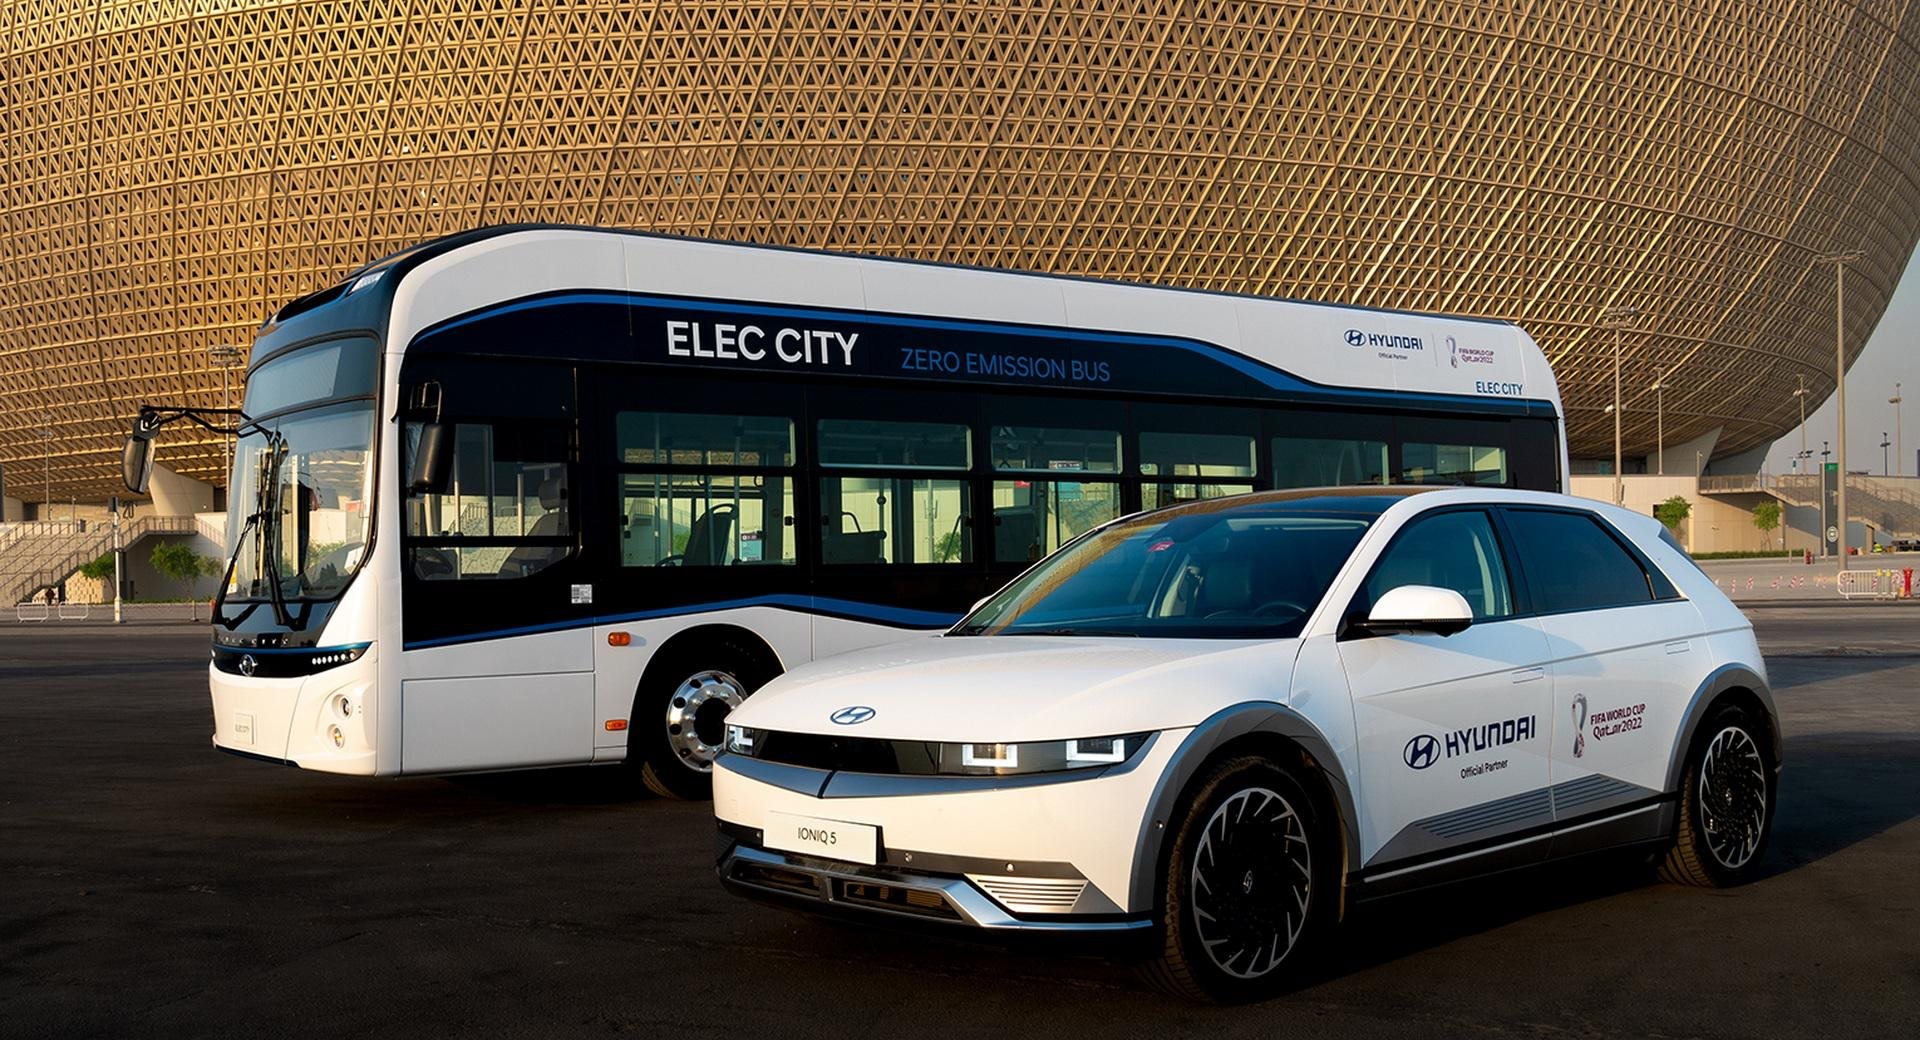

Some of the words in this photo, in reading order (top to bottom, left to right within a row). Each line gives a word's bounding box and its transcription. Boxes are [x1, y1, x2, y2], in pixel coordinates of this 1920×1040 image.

[667, 320, 766, 361] ELEC
[775, 327, 859, 365] CITY
[1368, 333, 1423, 350] HYUNDAI
[901, 348, 960, 373] ZERO
[966, 352, 1066, 379] EMISSION
[1071, 360, 1111, 382] BUS
[1476, 381, 1501, 394] ELEC
[1501, 383, 1523, 395] CITY
[1590, 712, 1606, 725] FIFA
[1606, 706, 1632, 721] WORLD
[1632, 703, 1646, 716] CUP
[1445, 715, 1536, 758] HYUNDAI
[1461, 764, 1484, 779] Official
[1484, 760, 1508, 773] Partner
[798, 827, 828, 845] IONIQ
[830, 832, 837, 845] 5
